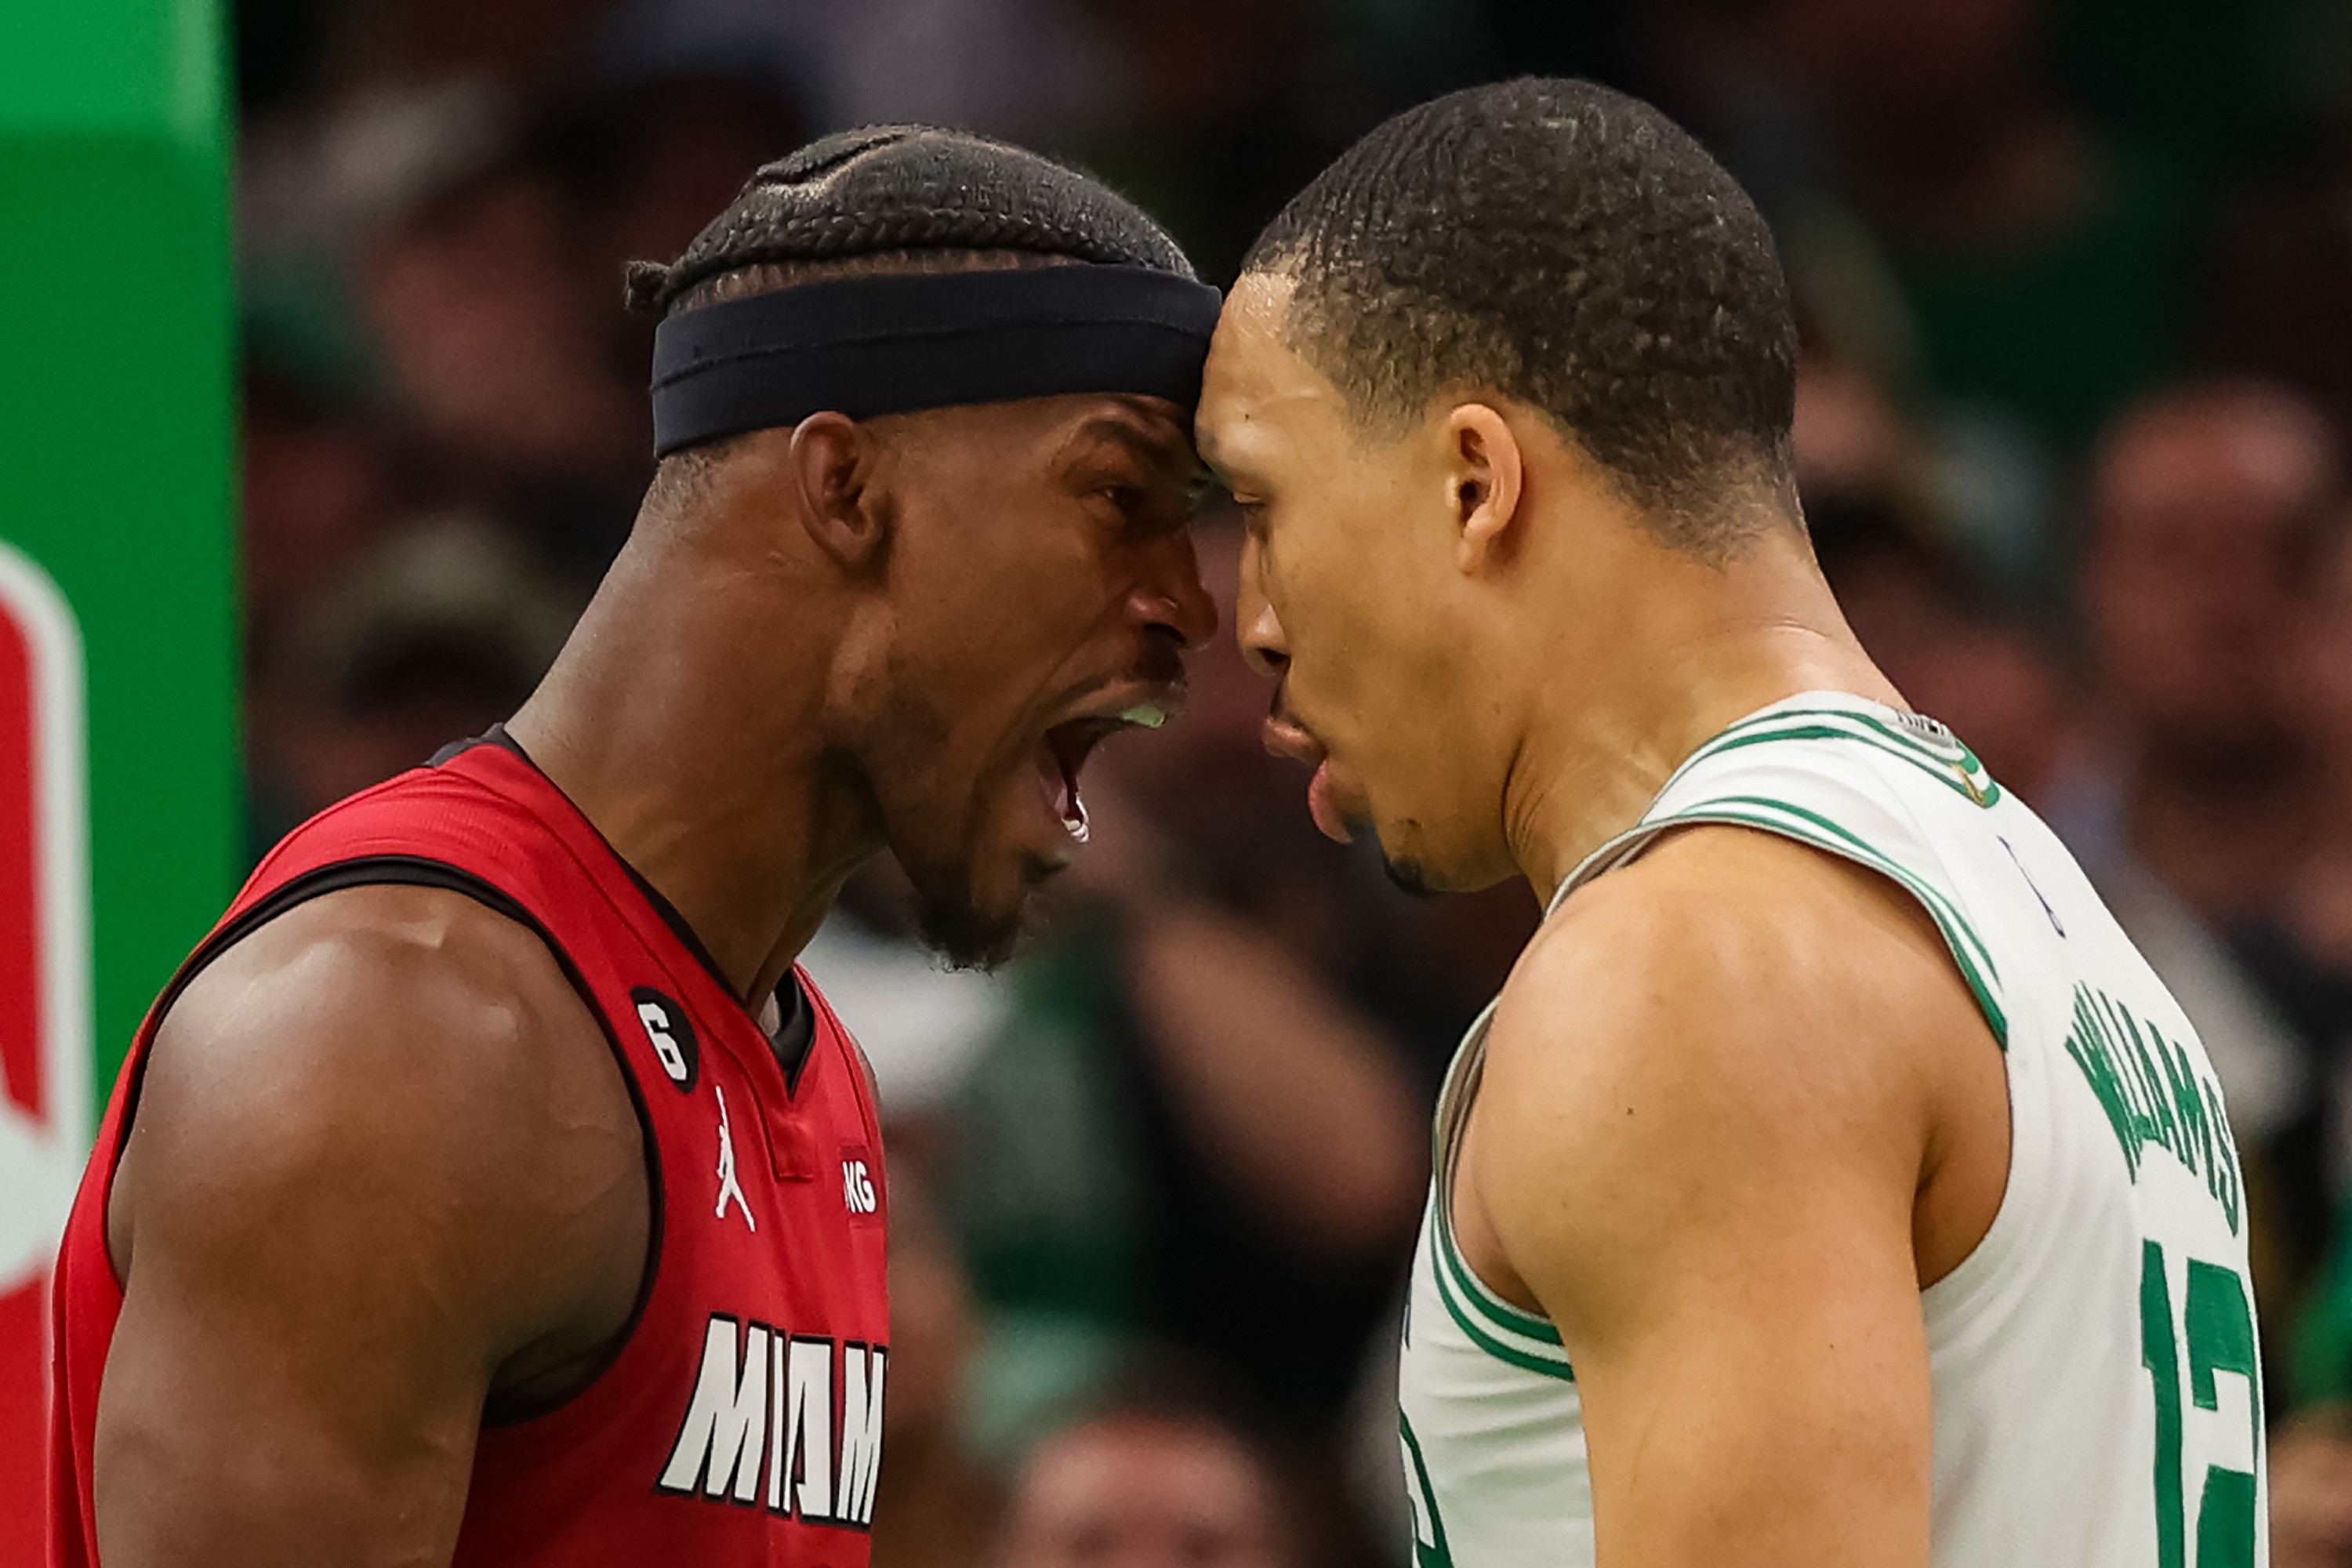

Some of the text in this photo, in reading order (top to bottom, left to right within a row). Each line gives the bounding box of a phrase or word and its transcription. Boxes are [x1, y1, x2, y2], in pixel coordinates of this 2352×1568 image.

[637, 1001, 688, 1081] 6
[842, 1160, 877, 1213] KG
[656, 1312, 889, 1529] MIAM
[2140, 1237, 2260, 1568] 12
